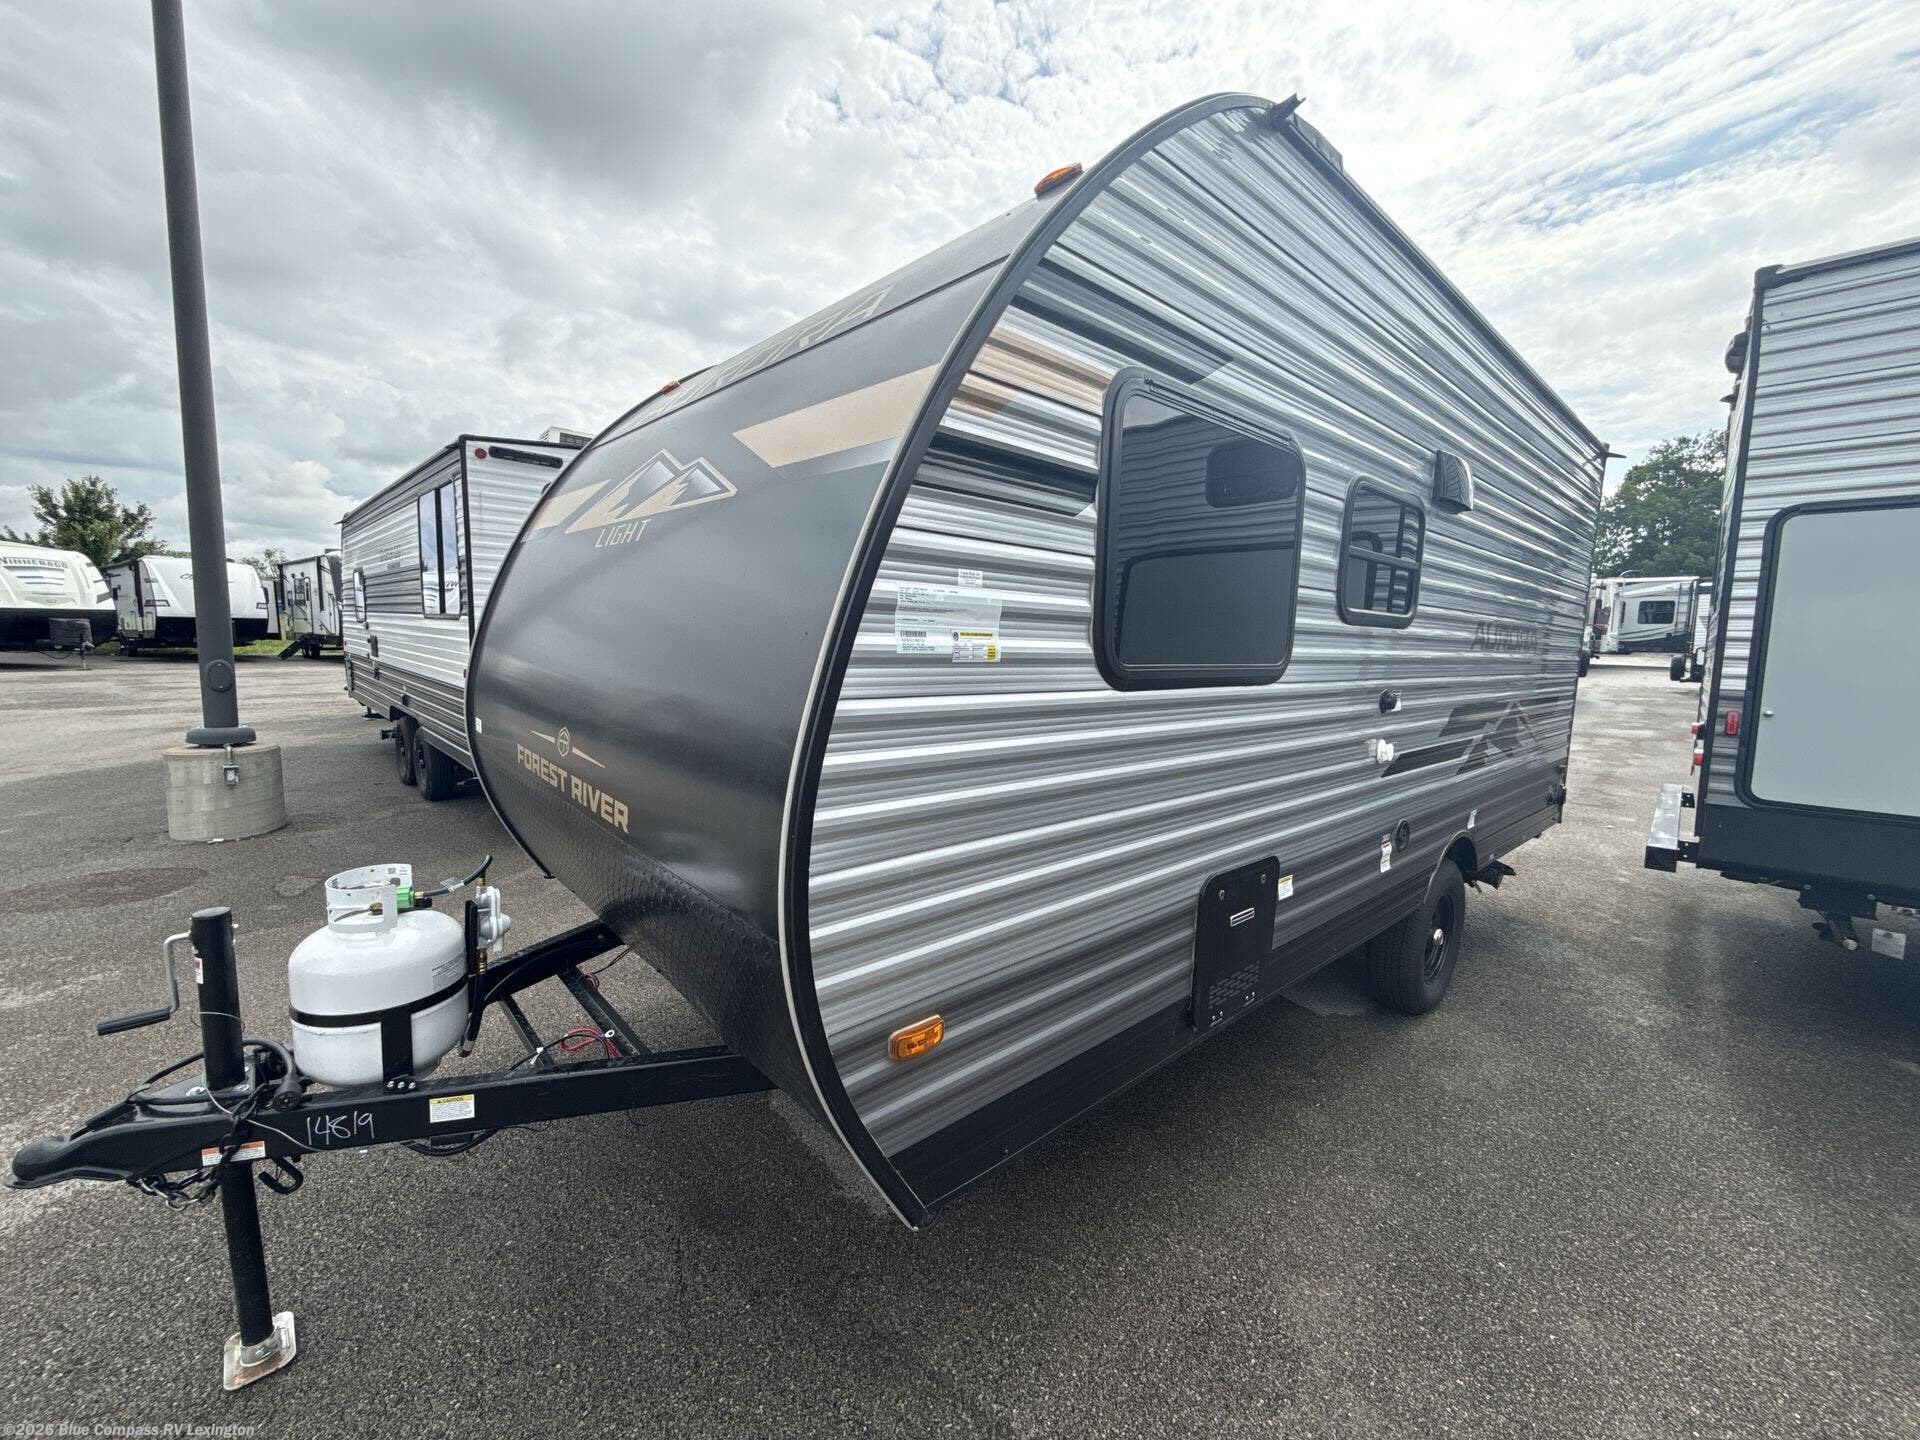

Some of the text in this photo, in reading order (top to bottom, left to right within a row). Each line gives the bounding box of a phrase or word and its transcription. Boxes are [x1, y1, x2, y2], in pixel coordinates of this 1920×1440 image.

[595, 518, 652, 548] LIGHT
[517, 743, 629, 834] FOREST RIVER
[306, 1110, 375, 1146] 14819
